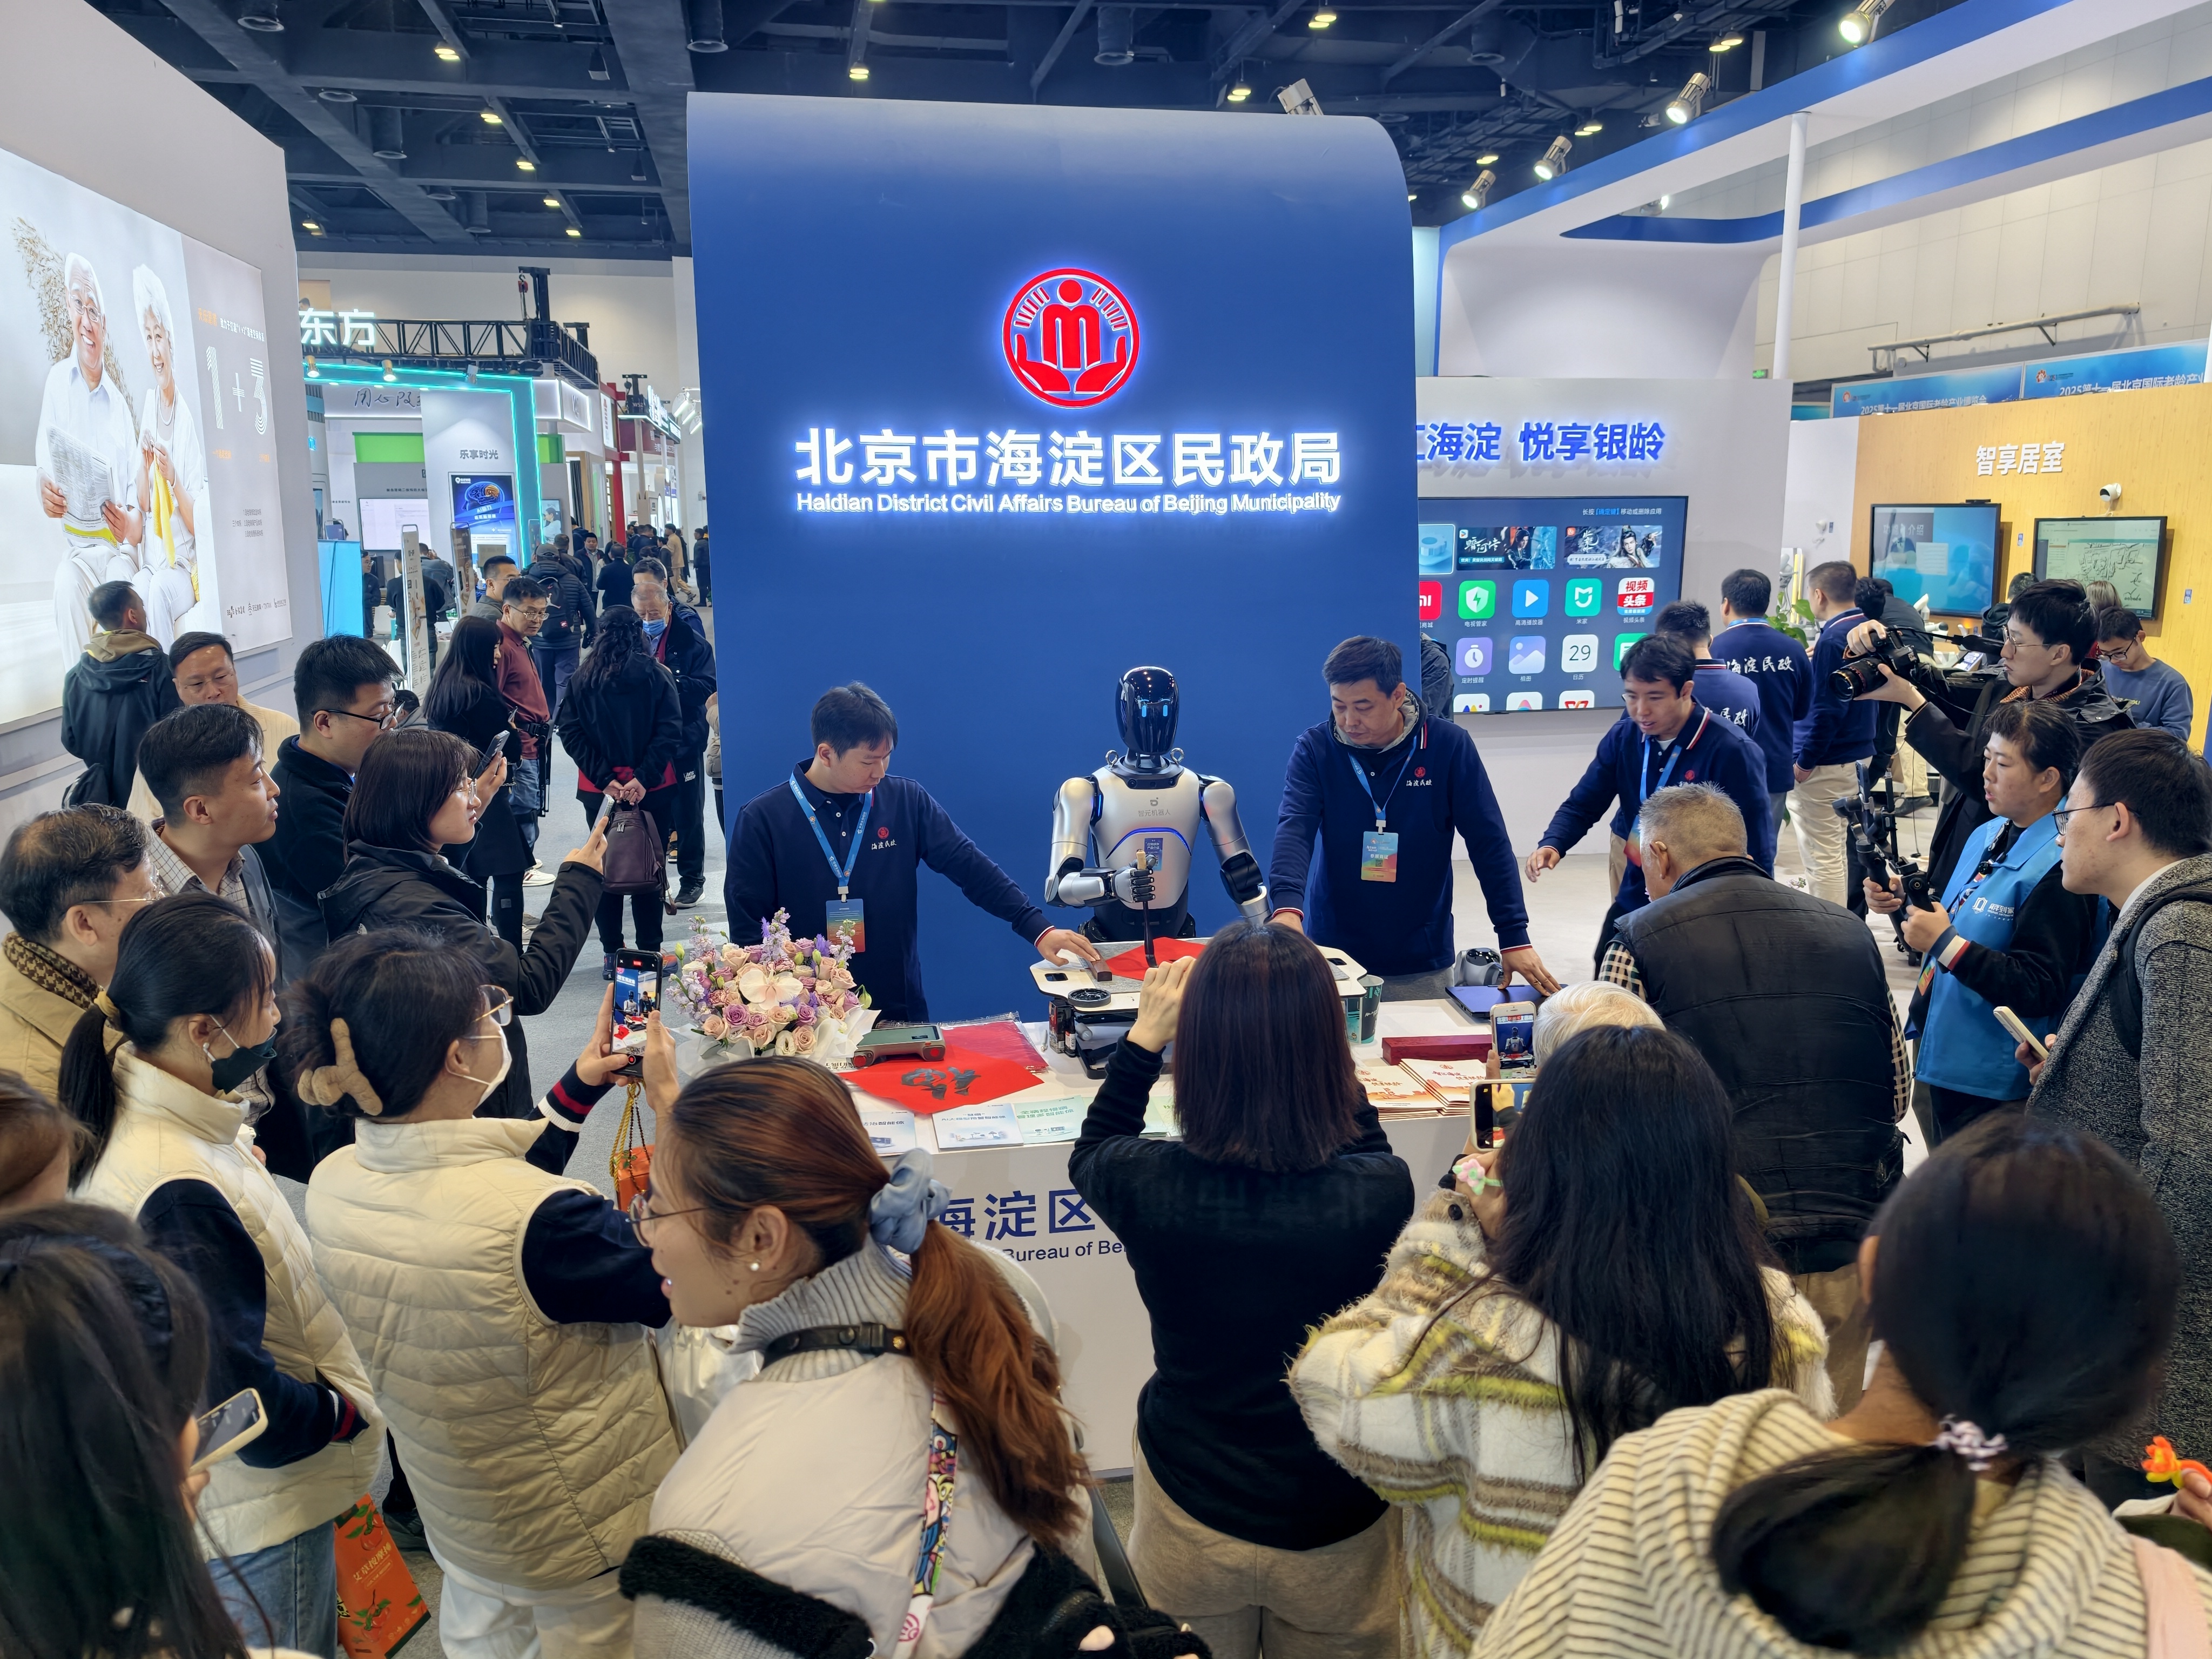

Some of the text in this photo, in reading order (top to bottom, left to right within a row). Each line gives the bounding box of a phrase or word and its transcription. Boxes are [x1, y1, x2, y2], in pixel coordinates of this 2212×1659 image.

[299, 308, 374, 345] 东方
[1519, 422, 1665, 462] 悦享银龄
[460, 449, 498, 460] 乐享时光
[795, 428, 1341, 487] 北京市海淀区民政局
[1976, 441, 2065, 476] 智享居室
[797, 492, 1341, 515] Haidian District Civil Affairs Bureau of Beijing Municipality
[1626, 580, 1648, 592] 视频
[1623, 595, 1646, 607] 头条
[1569, 645, 1590, 661] 29
[1727, 656, 1795, 675] 海淀民政
[1720, 707, 1748, 726] 民政
[1138, 809, 1171, 817] 智元机器人
[871, 839, 897, 850] 海淀民政
[1075, 1242, 1093, 1257] of
